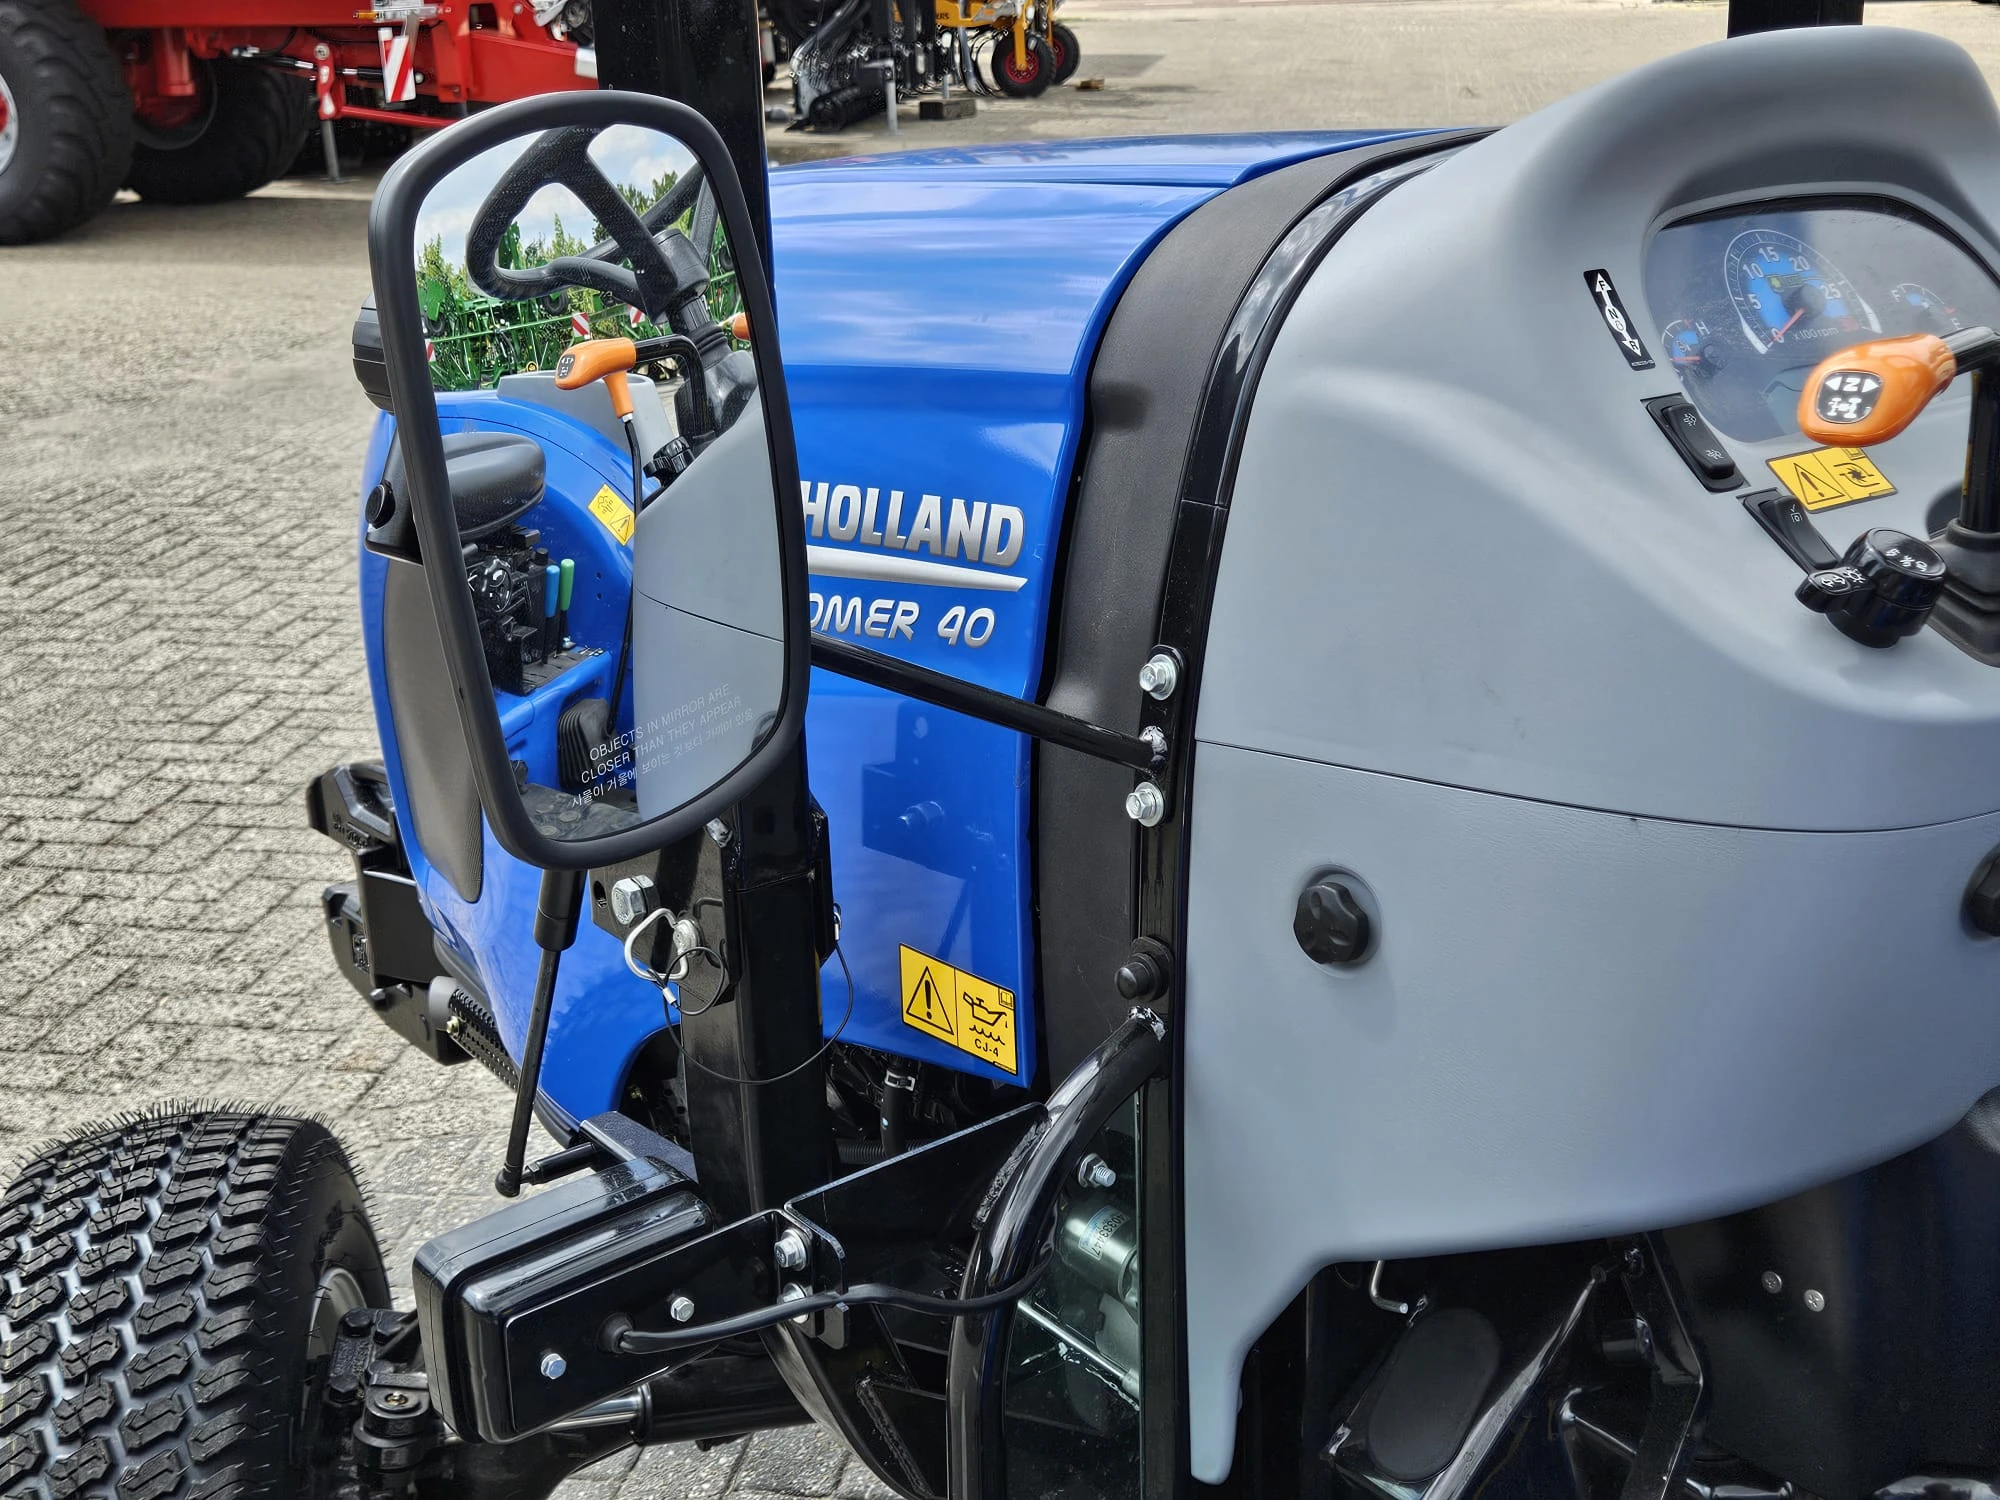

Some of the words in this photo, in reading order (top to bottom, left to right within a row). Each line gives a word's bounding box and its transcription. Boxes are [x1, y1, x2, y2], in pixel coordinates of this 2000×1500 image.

[1758, 246, 1780, 263] 15
[1742, 263, 1764, 279] 10
[1789, 256, 1811, 272] 20
[1598, 280, 1606, 290] F
[1820, 283, 1842, 300] 25
[1747, 294, 1762, 310] 5
[1890, 290, 1901, 303] F
[1607, 308, 1619, 320] N
[1695, 321, 1710, 336] H
[1771, 327, 1785, 344] 0
[1629, 340, 1639, 350] R
[800, 480, 1024, 568] HOLLAND
[937, 605, 996, 648] 40
[590, 726, 644, 761] OBJECTS
[647, 721, 660, 735] IN
[660, 696, 705, 726] MIRROR
[708, 684, 730, 705] ARE
[581, 751, 630, 784] CLOSER
[634, 735, 665, 760] THAN
[667, 718, 696, 741] THEY
[699, 697, 742, 725] APPEAR
[571, 784, 604, 808] 사물이
[974, 1038, 1000, 1057] CJ-4
